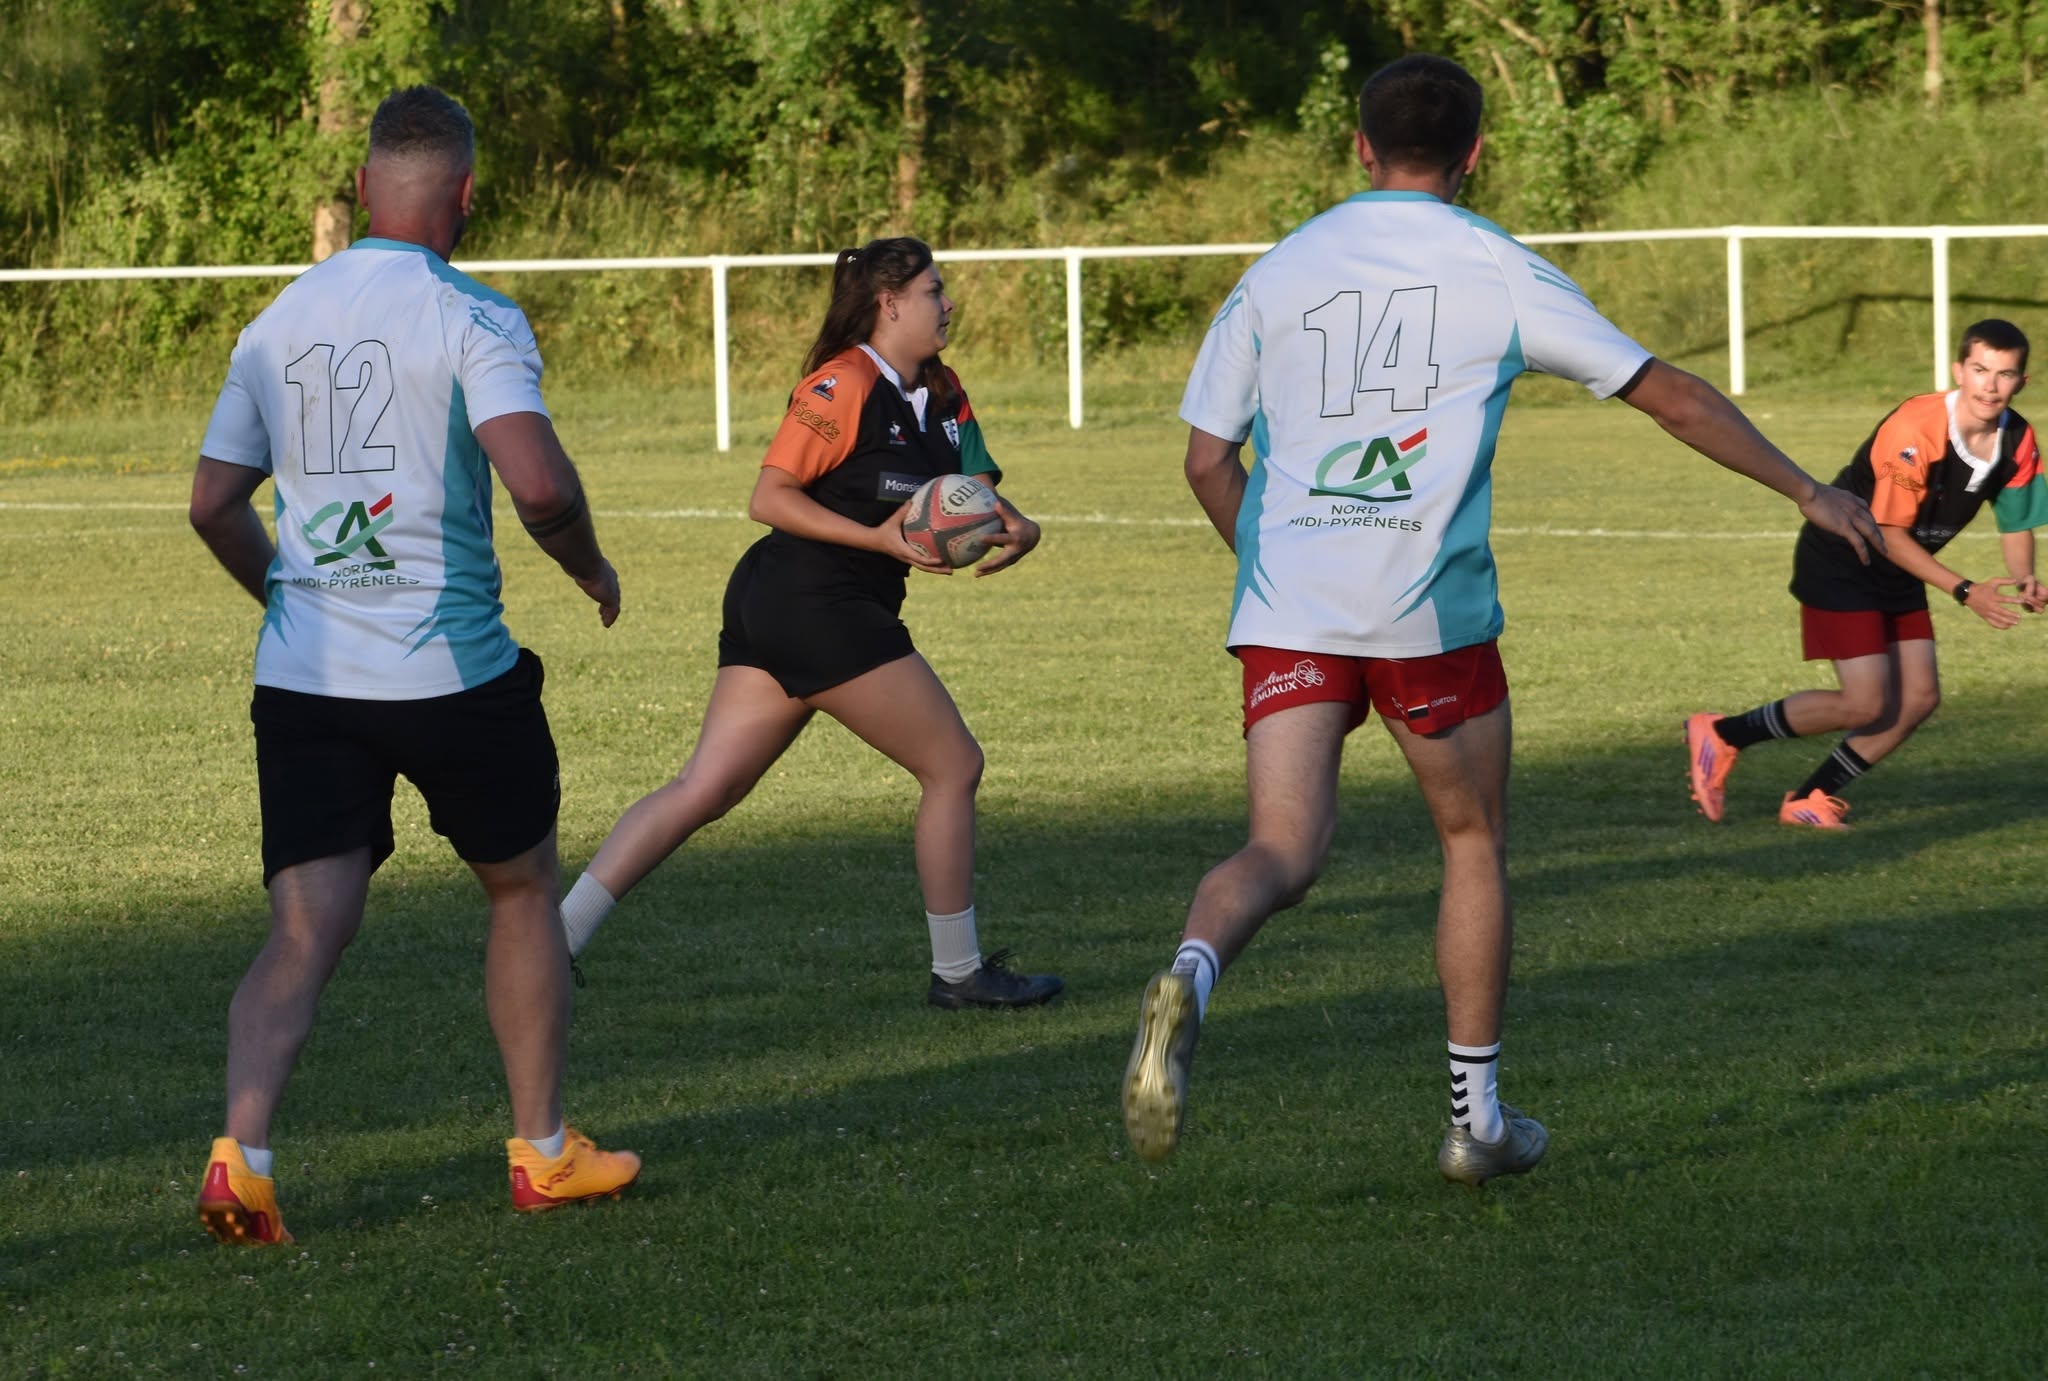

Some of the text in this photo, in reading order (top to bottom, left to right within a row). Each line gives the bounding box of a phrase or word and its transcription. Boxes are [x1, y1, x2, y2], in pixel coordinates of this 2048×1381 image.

[1303, 285, 1440, 418] 14
[285, 339, 396, 475] 12
[1330, 504, 1381, 515] NORD
[1287, 513, 1423, 532] MIDI-PYRÉNÉES
[330, 564, 375, 578] NORD
